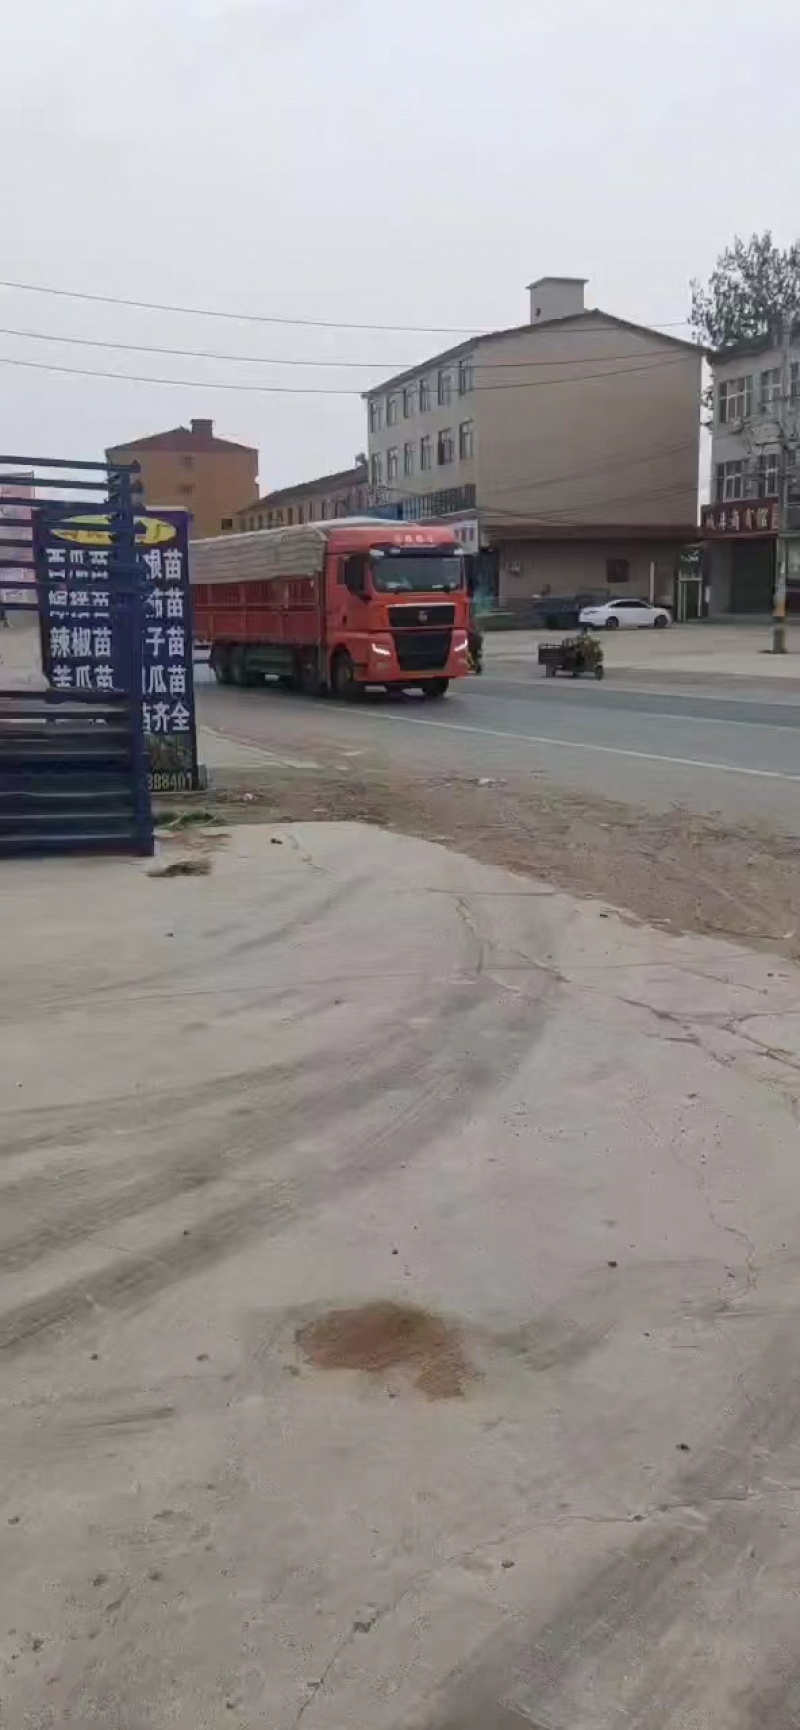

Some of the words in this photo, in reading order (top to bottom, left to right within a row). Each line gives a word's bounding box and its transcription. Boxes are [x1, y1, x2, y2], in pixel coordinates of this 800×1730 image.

[50, 626, 112, 658] 辣椒苗
[144, 626, 185, 658] 子苗
[141, 664, 187, 694] 瓜苗
